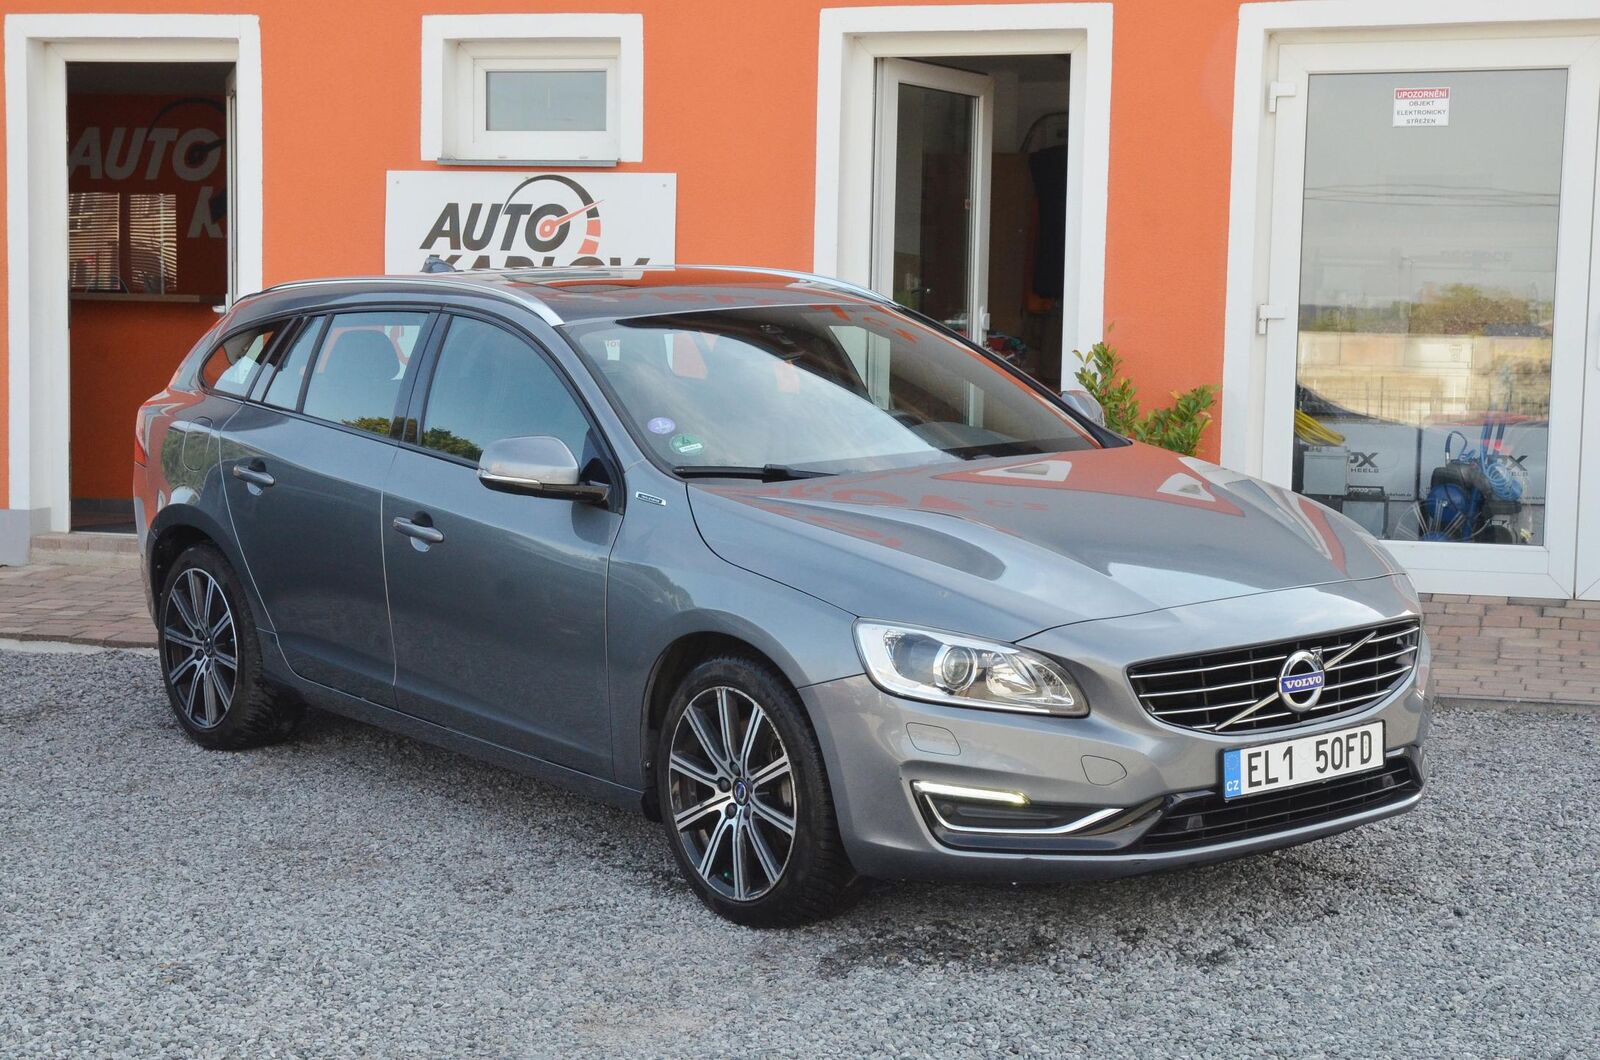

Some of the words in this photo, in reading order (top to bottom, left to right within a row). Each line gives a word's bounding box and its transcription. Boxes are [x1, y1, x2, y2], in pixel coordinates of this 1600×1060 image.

[69, 127, 221, 181] AUTO
[419, 202, 571, 253] AUTO
[1284, 675, 1322, 689] VOLVO
[1247, 745, 1293, 788] EL1
[1315, 730, 1373, 774] 50FD
[1226, 780, 1240, 792] CZ
